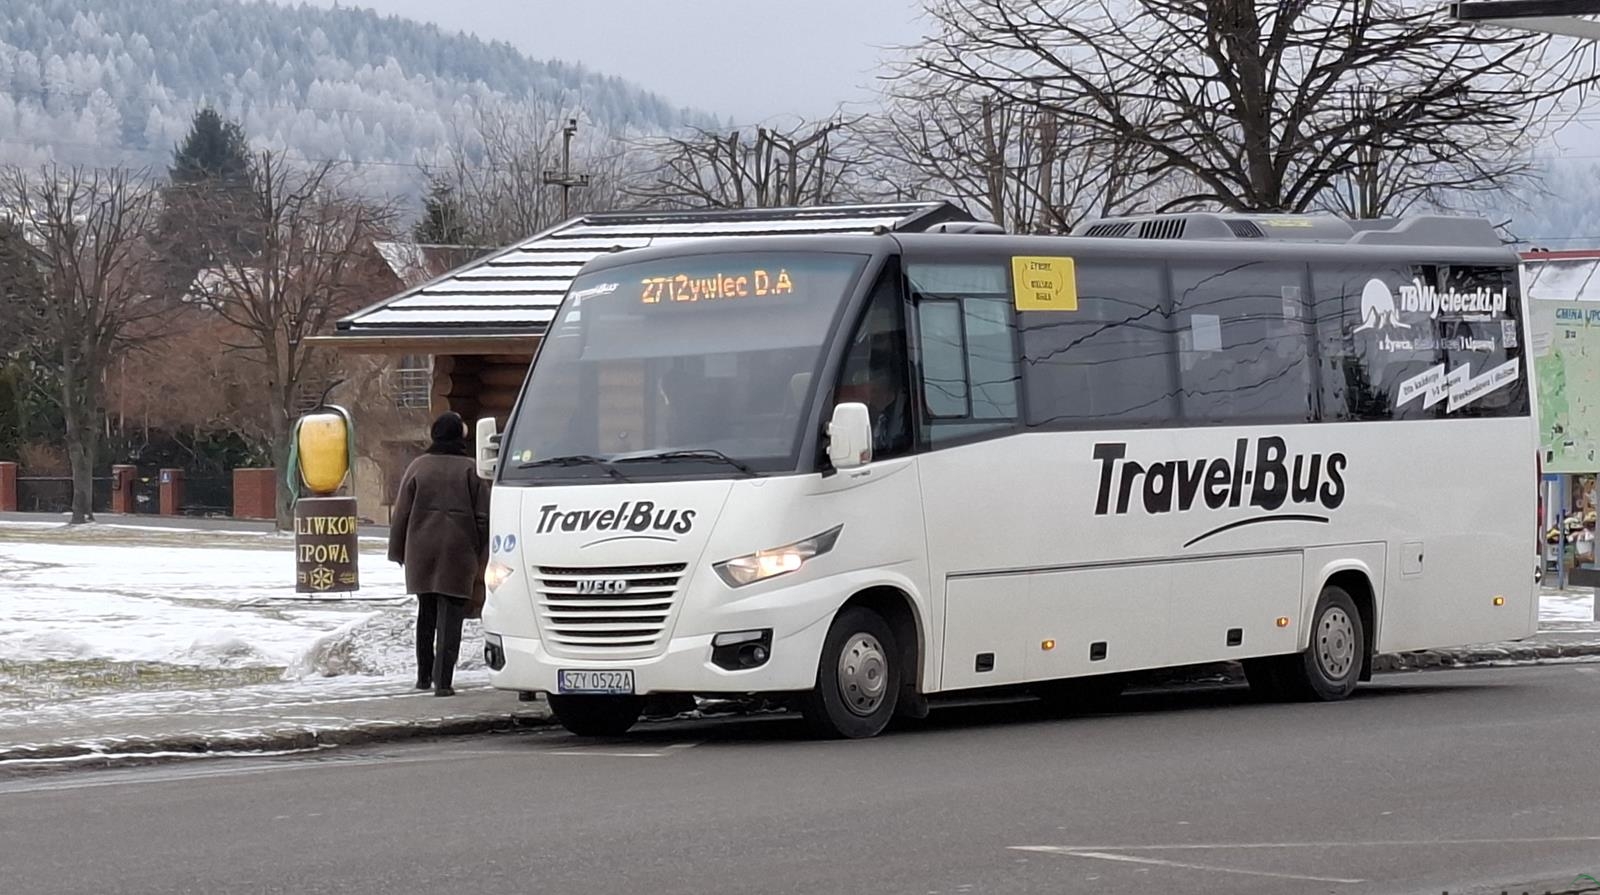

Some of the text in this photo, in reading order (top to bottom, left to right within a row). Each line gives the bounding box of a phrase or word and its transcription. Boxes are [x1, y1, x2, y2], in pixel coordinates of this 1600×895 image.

[1093, 436, 1347, 515] Travel-Bus
[536, 501, 697, 534] Travel-Bus
[576, 579, 628, 594] IVECO
[565, 672, 631, 688] SZY 0522A
